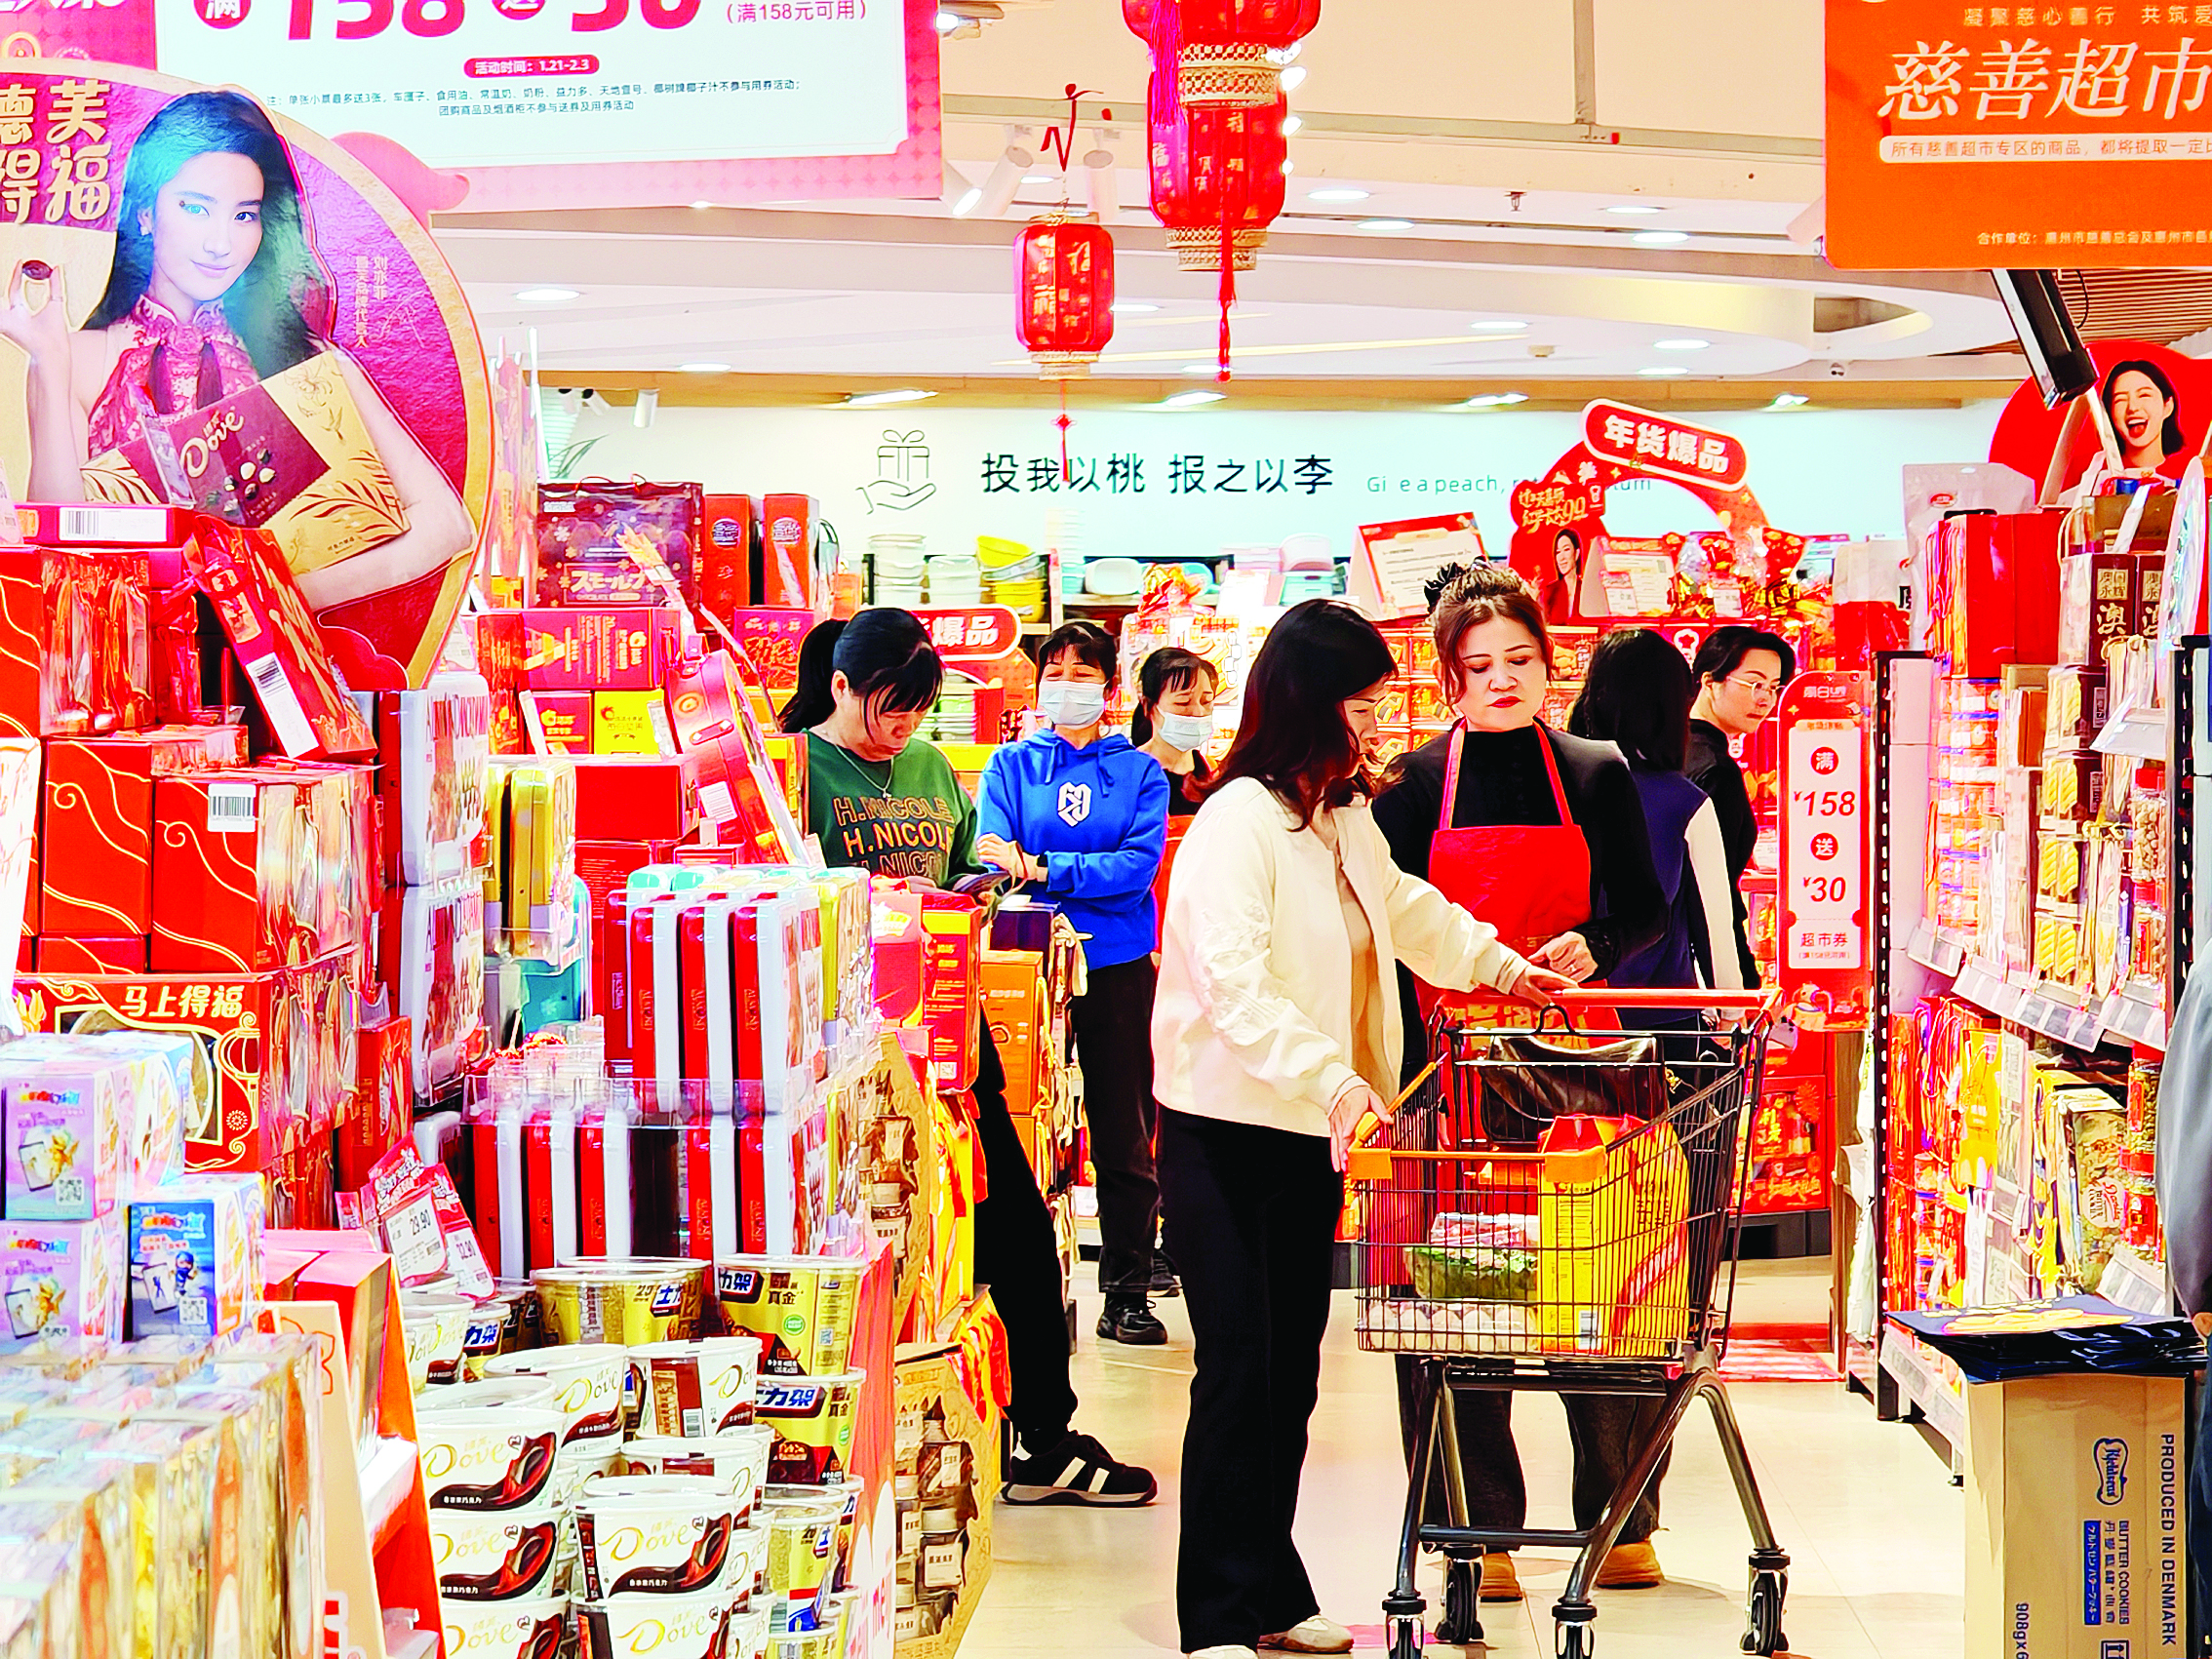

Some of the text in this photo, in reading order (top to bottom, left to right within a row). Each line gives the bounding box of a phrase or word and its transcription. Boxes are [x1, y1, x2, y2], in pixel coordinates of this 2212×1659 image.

[1877, 37, 2212, 120] 慈善超市
[179, 411, 245, 478] Dove
[1603, 415, 1729, 474] 年货爆品
[980, 453, 1333, 495] 投我以桃 报之以李
[917, 614, 999, 648] 爆品
[1794, 791, 1855, 817] ¥158
[1815, 838, 1835, 856] 送
[1803, 876, 1846, 903] ¥30
[1800, 932, 1848, 947] 超市券
[120, 984, 245, 1018] 马上得福
[422, 1442, 510, 1479] Dove
[598, 1524, 695, 1561] Dove
[2160, 1434, 2176, 1645] PRODUCED IN DENMARK
[2118, 1521, 2130, 1625] BUTTER COOKIES
[616, 1614, 710, 1655] Dove
